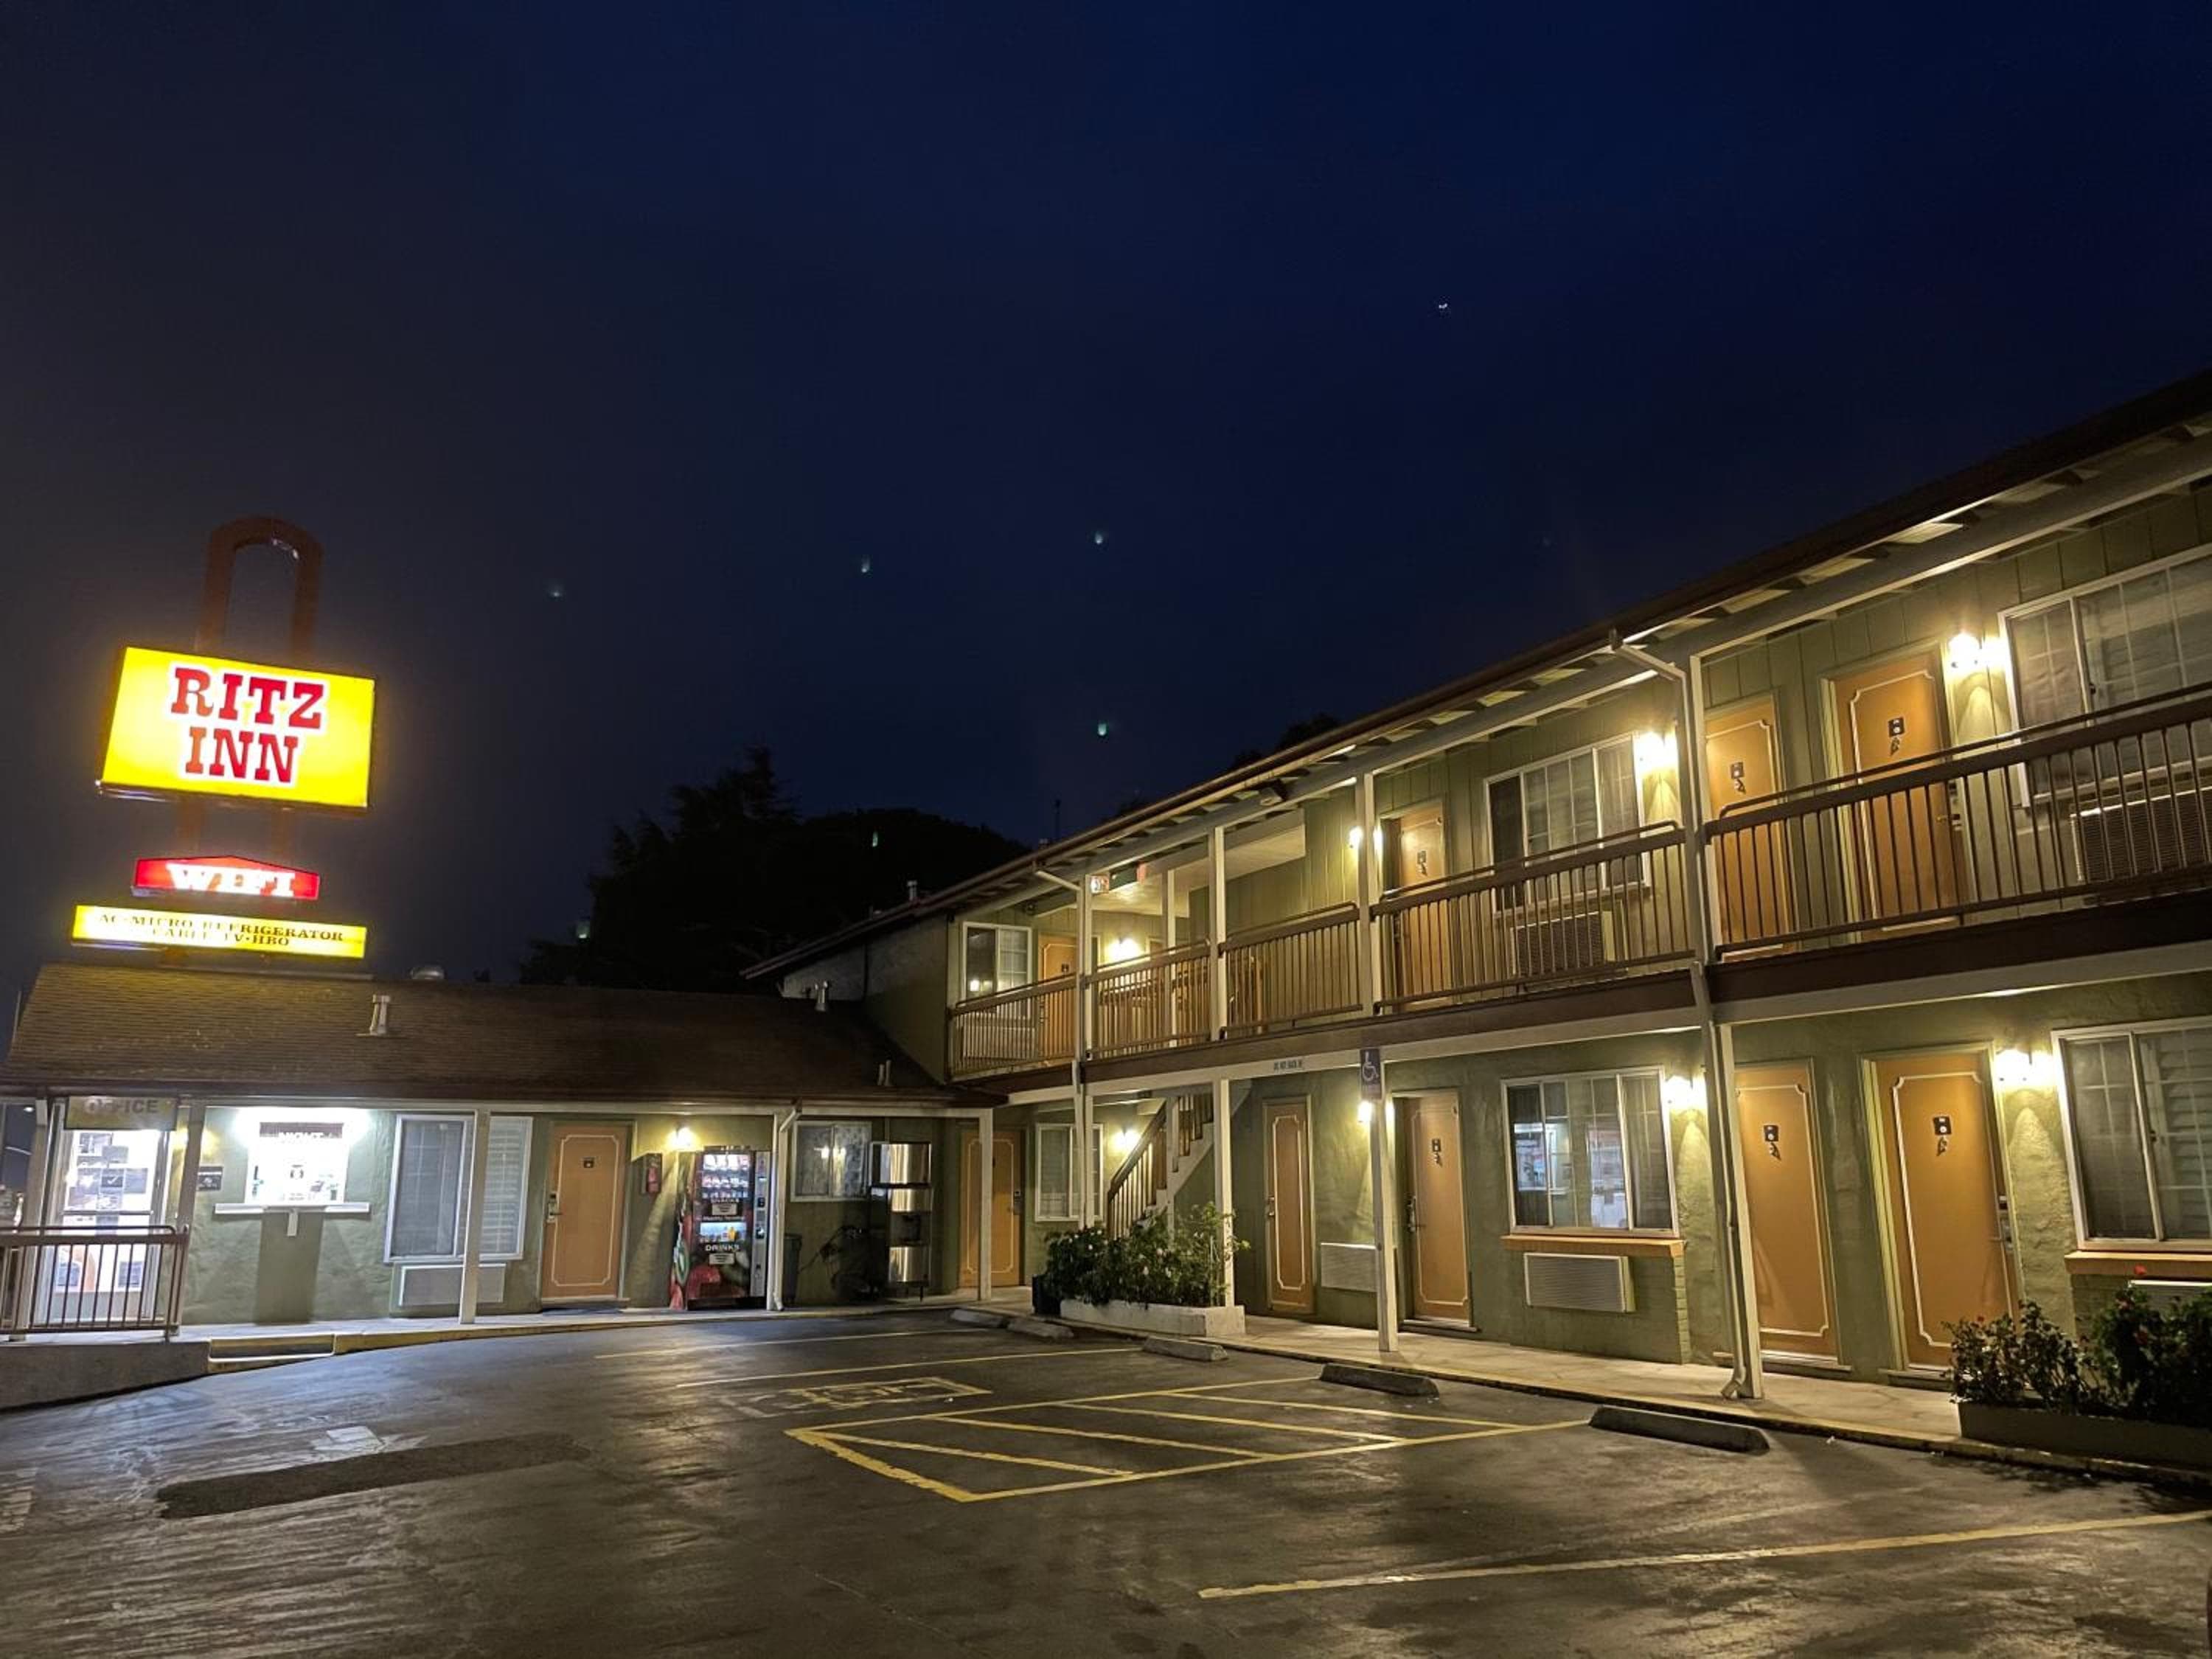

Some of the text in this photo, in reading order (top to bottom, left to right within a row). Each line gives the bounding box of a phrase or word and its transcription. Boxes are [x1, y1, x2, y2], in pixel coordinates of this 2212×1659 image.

[170, 667, 324, 730] RITZ
[185, 726, 299, 783] INN
[705, 1244, 740, 1252] DRINKS
